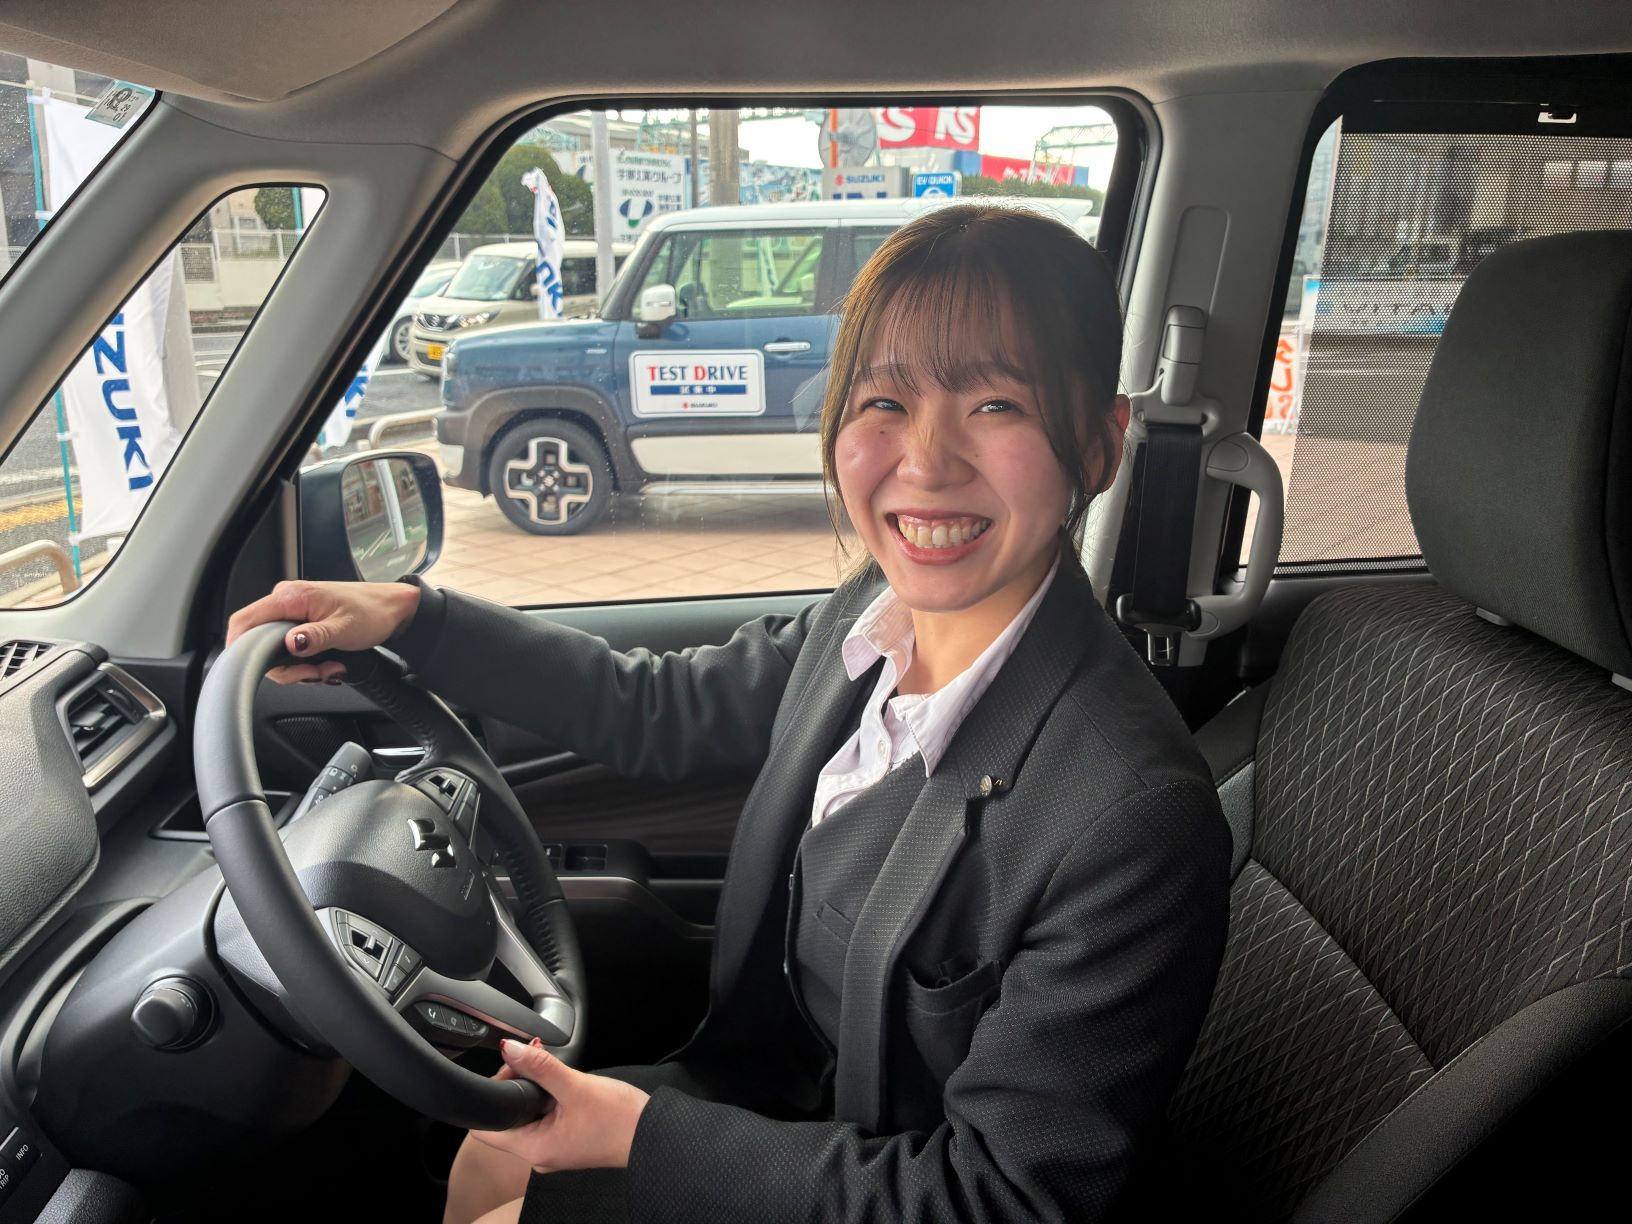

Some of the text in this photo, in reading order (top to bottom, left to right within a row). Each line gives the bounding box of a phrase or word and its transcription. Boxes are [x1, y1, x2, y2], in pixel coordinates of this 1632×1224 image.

[647, 365, 749, 381] TEST DRIVE
[93, 312, 154, 491] ZUKI
[16, 1144, 28, 1160] INFO
